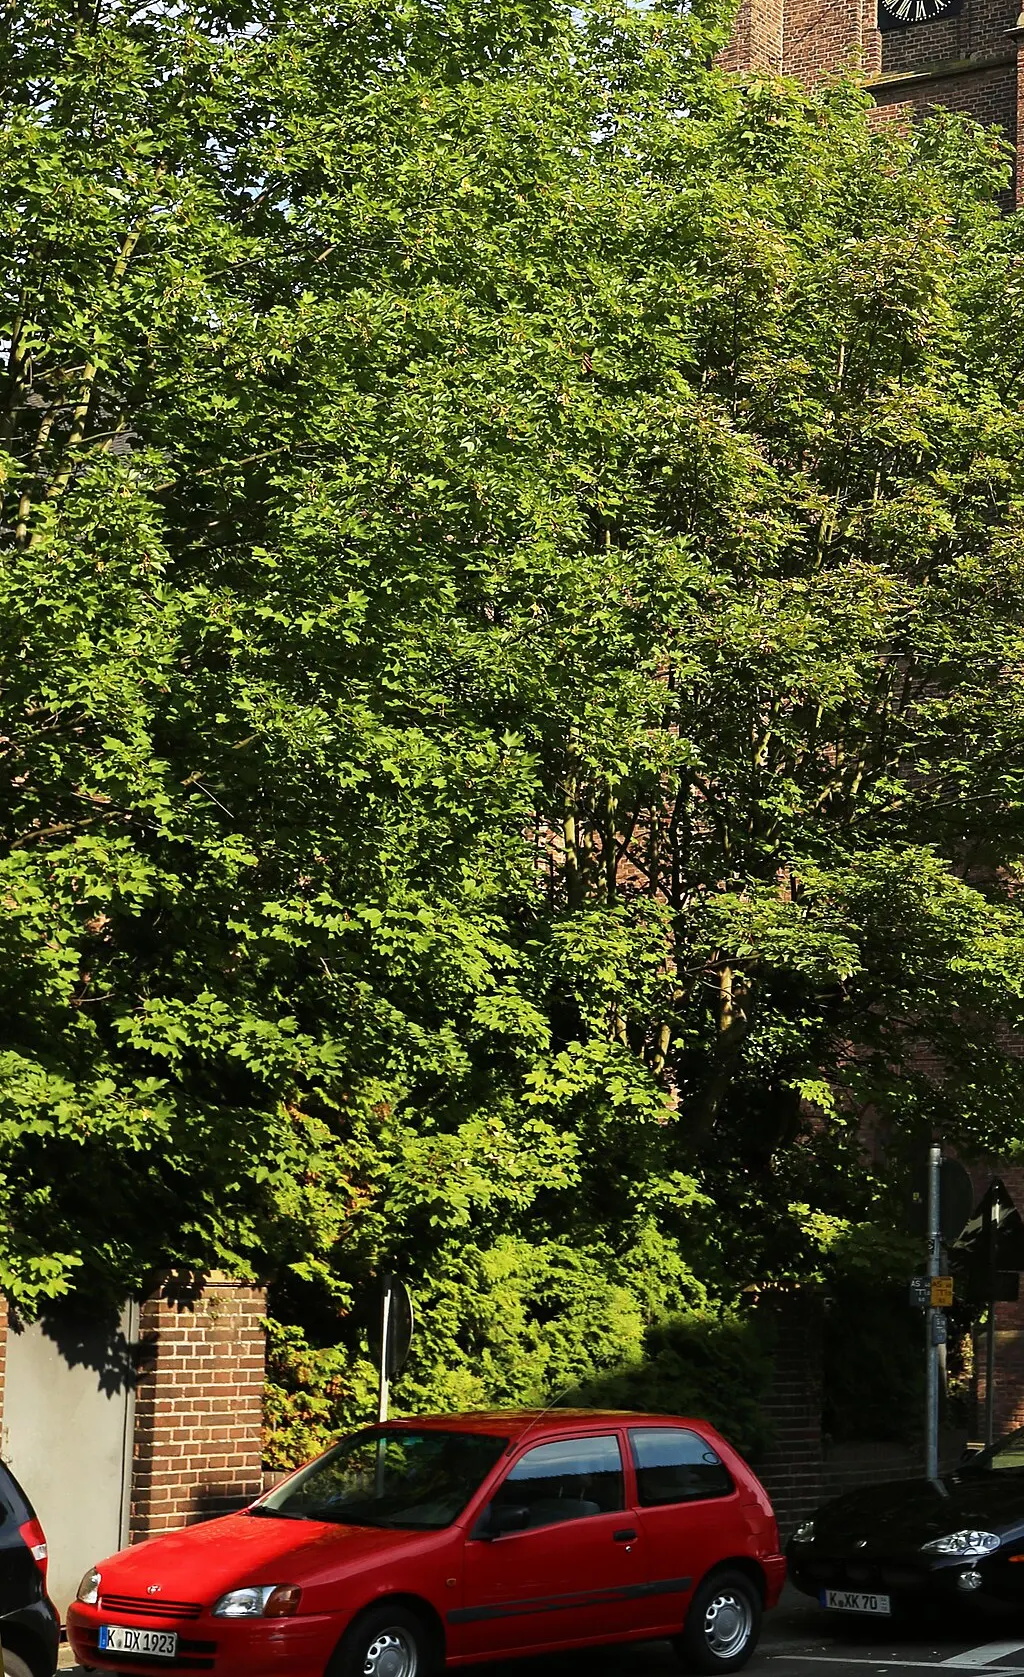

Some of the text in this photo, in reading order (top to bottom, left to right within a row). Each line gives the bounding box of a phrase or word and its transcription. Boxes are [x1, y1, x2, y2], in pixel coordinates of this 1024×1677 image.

[915, 0, 927, 18] VI
[829, 1592, 837, 1606] K
[844, 1593, 860, 1608] XK
[862, 1595, 877, 1610] 70
[108, 1629, 175, 1654] K DX 1923
